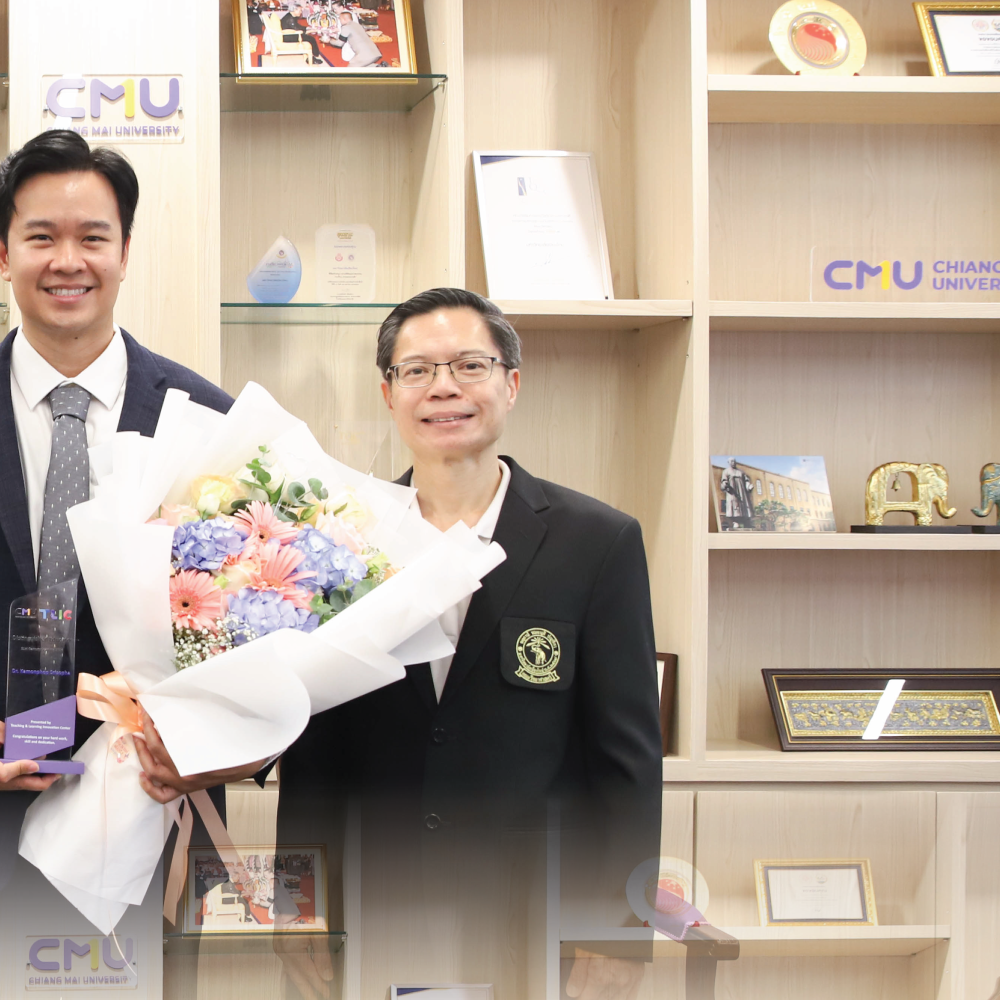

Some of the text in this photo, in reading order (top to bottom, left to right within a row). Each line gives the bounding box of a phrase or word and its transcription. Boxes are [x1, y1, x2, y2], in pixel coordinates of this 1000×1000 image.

[46, 78, 180, 118] CMU
[92, 126, 112, 136] MAI
[116, 126, 180, 136] UNIVERSITY
[824, 260, 923, 290] CMU
[932, 278, 1000, 290] UNIVER
[39, 608, 72, 620] TLIC
[29, 938, 133, 970] CMU
[29, 976, 62, 985] CHIANG
[64, 976, 80, 985] MAI
